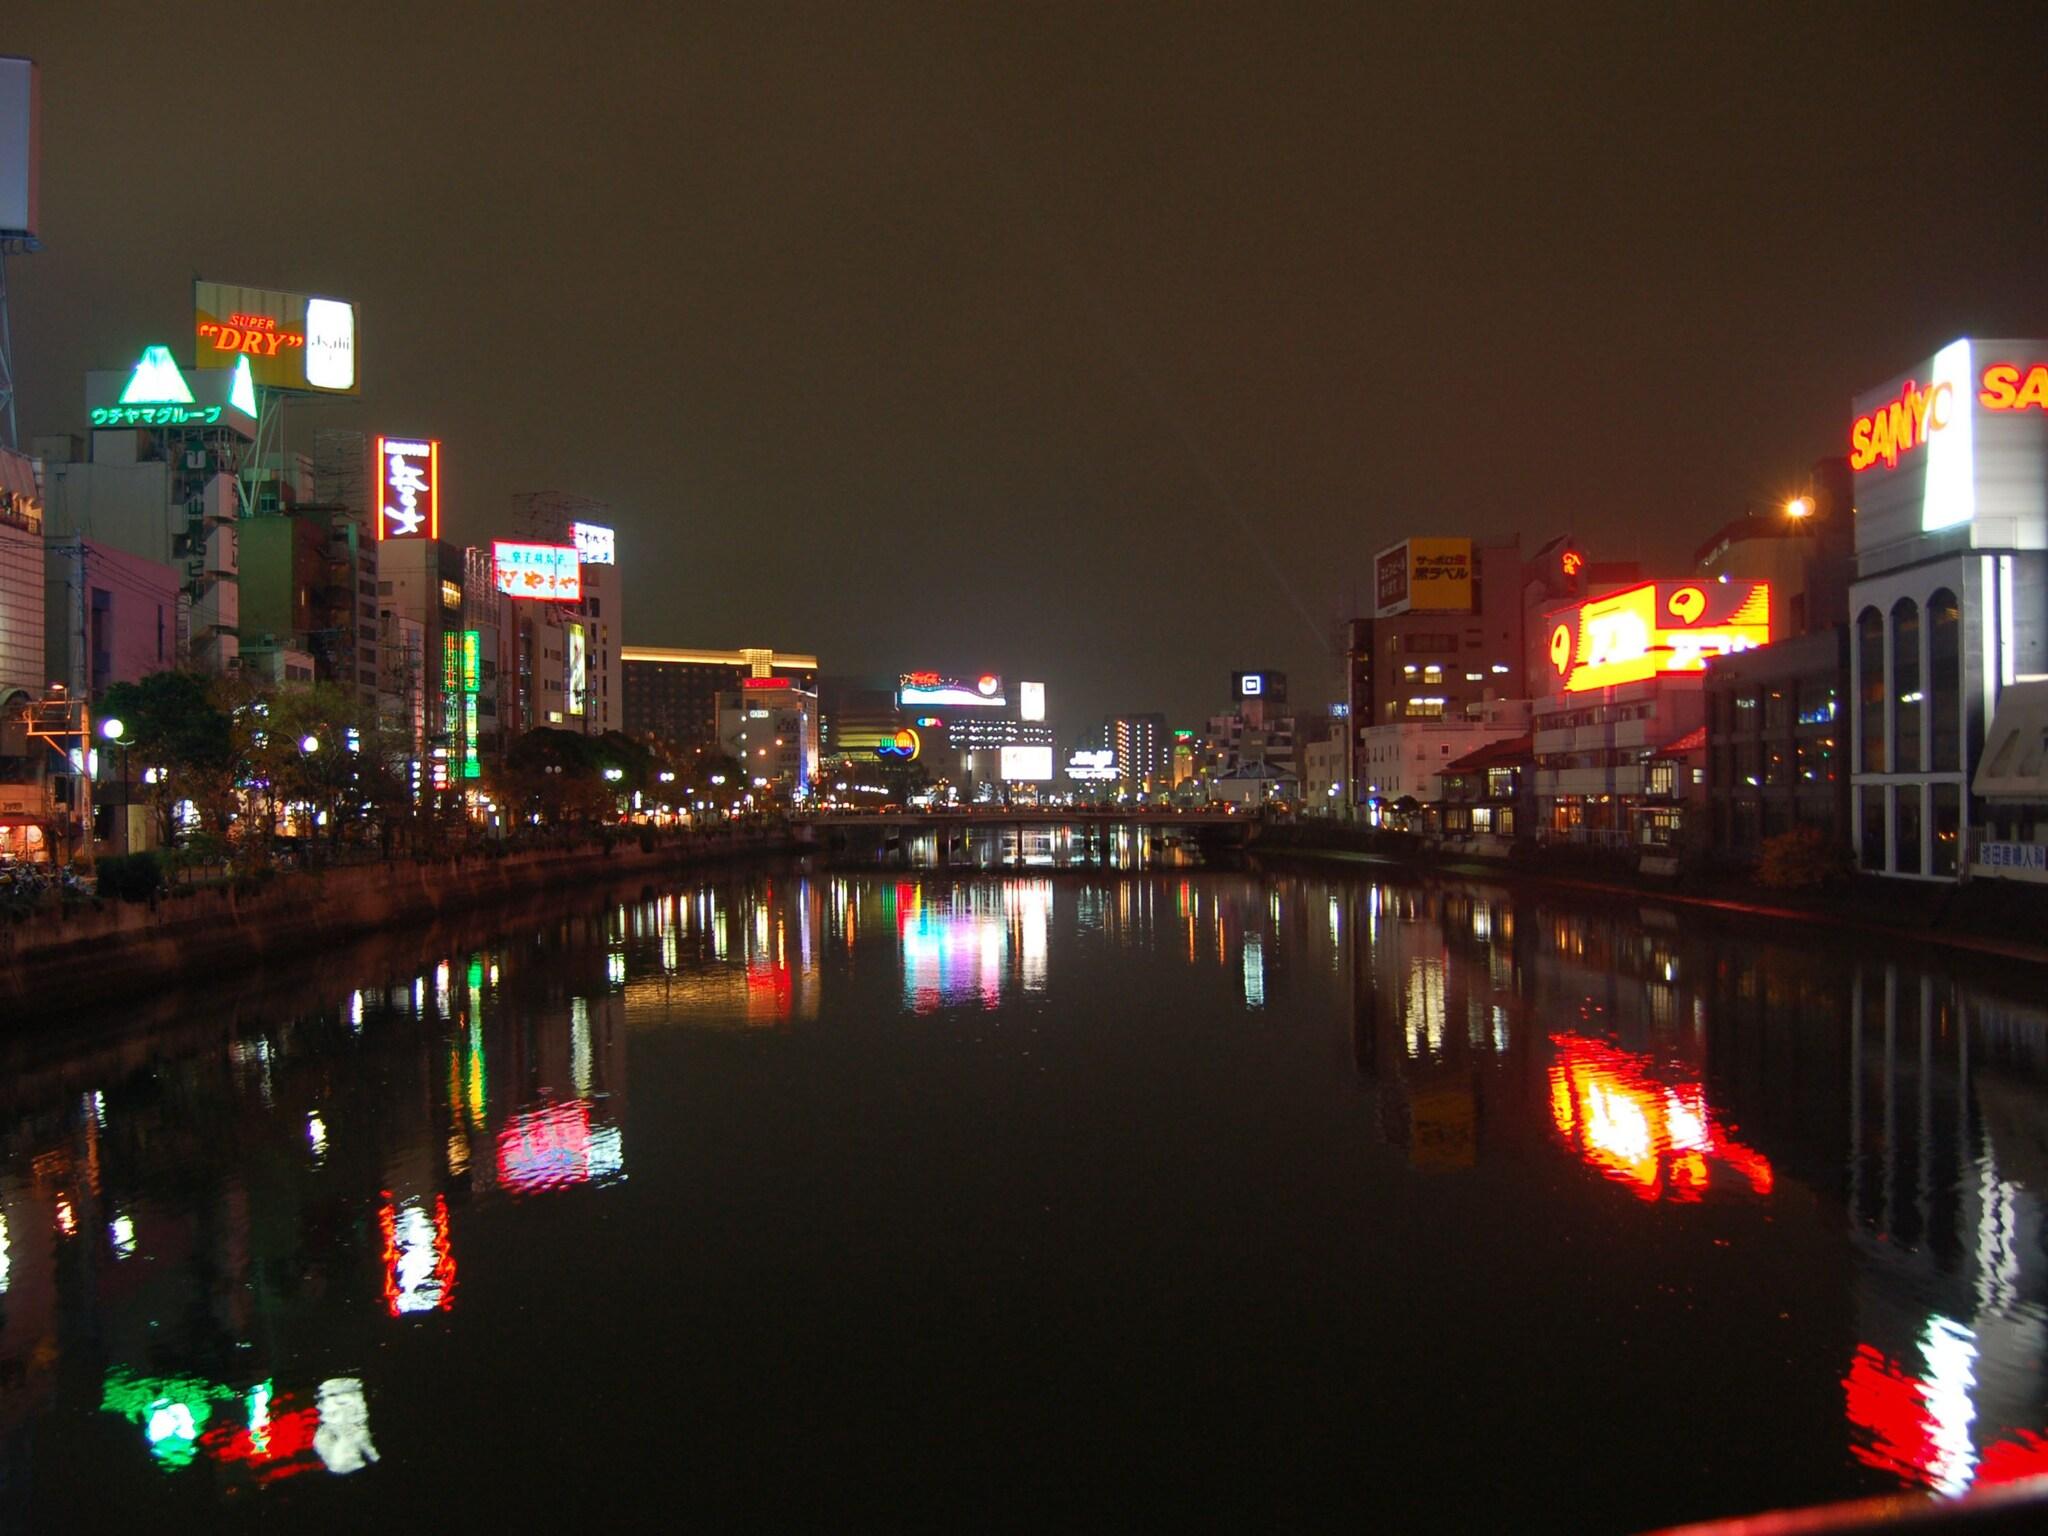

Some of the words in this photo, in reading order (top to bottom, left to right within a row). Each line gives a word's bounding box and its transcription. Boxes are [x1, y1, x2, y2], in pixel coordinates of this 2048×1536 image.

[229, 313, 276, 331] SUPER
[90, 406, 222, 426] ウチヤマグループ
[1850, 380, 1953, 470] SANYO
[1415, 567, 1469, 581] 黒ラベル
